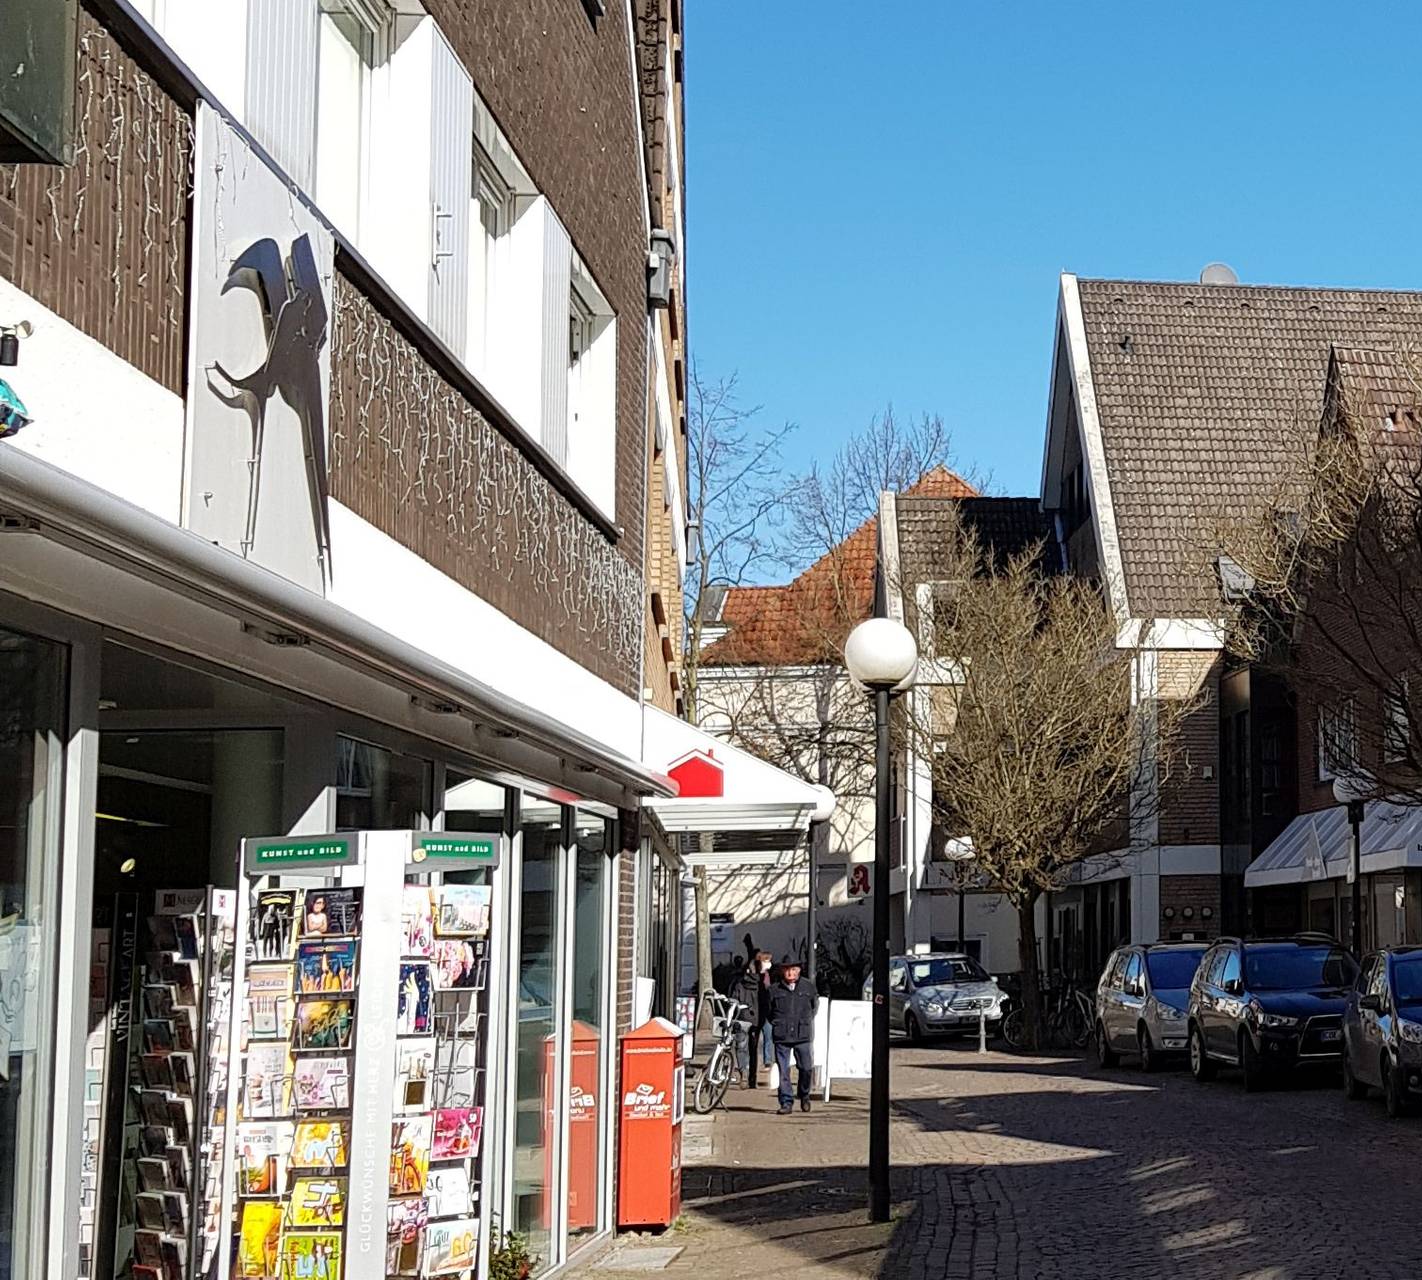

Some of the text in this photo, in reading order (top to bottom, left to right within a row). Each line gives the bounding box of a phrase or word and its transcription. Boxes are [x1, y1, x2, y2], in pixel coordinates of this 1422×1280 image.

[261, 848, 294, 858] KUNST
[319, 846, 342, 854] BILD
[426, 844, 453, 852] KUNST
[471, 845, 489, 853] BILD
[624, 1091, 666, 1106] Brief
